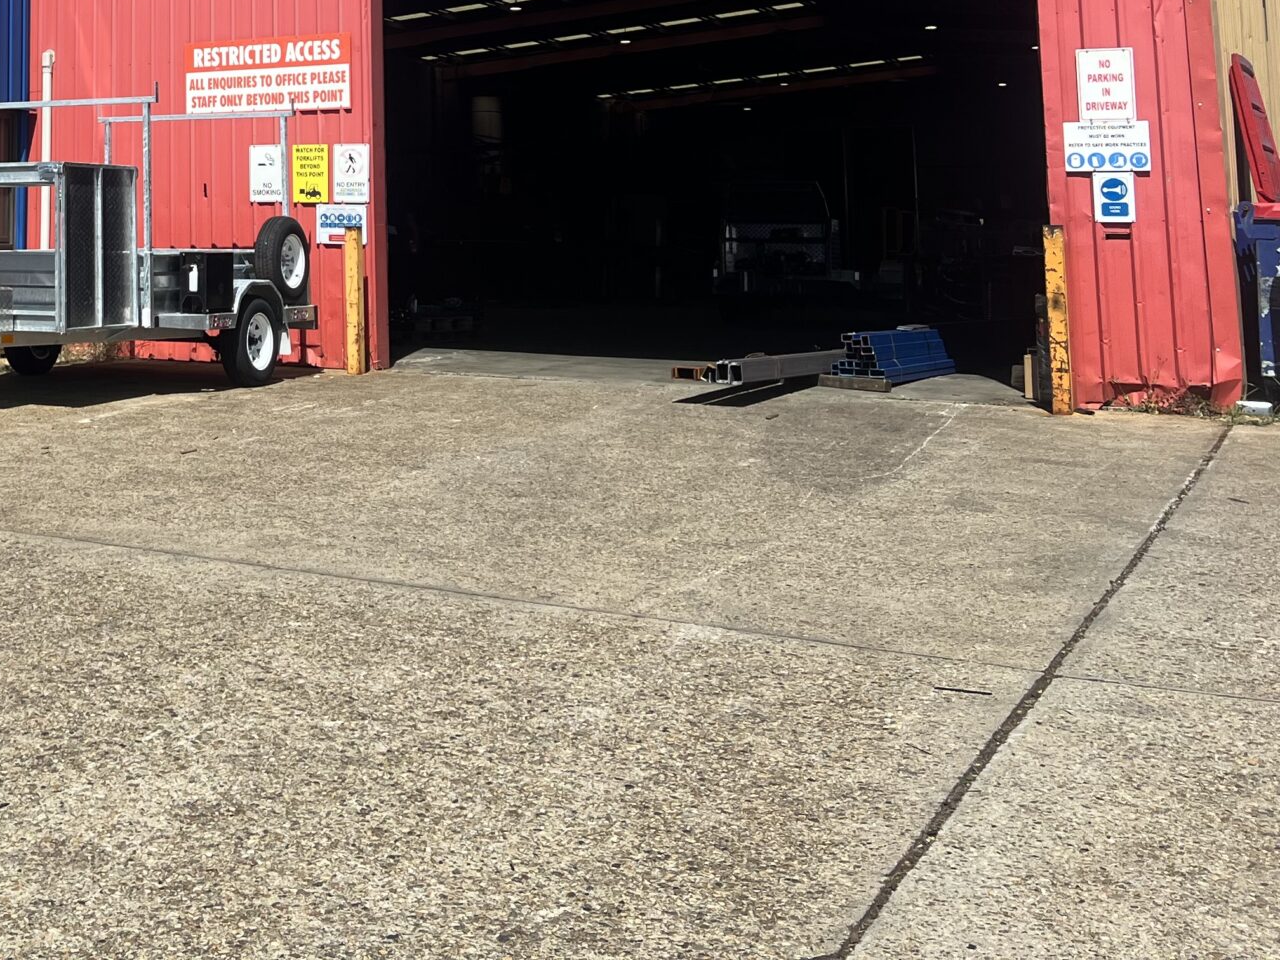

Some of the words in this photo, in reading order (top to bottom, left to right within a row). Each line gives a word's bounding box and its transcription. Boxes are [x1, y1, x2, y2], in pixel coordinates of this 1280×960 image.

[193, 43, 281, 68] RESTRICTED
[285, 38, 340, 63] ACCESS
[1098, 59, 1110, 68] NO
[189, 77, 205, 91] ALL
[207, 75, 257, 91] ENQUIRIES
[260, 74, 272, 88] TO
[275, 72, 307, 87] OFFICE
[310, 70, 346, 85] PLEASE
[1087, 73, 1124, 83] PARKING
[1101, 87, 1110, 97] IN
[191, 95, 217, 109] STAFF
[220, 94, 243, 107] ONLY
[246, 92, 285, 106] BEYOND
[288, 90, 309, 104] THIS
[313, 89, 344, 103] POINT
[1085, 101, 1128, 111] DRIVEWAY
